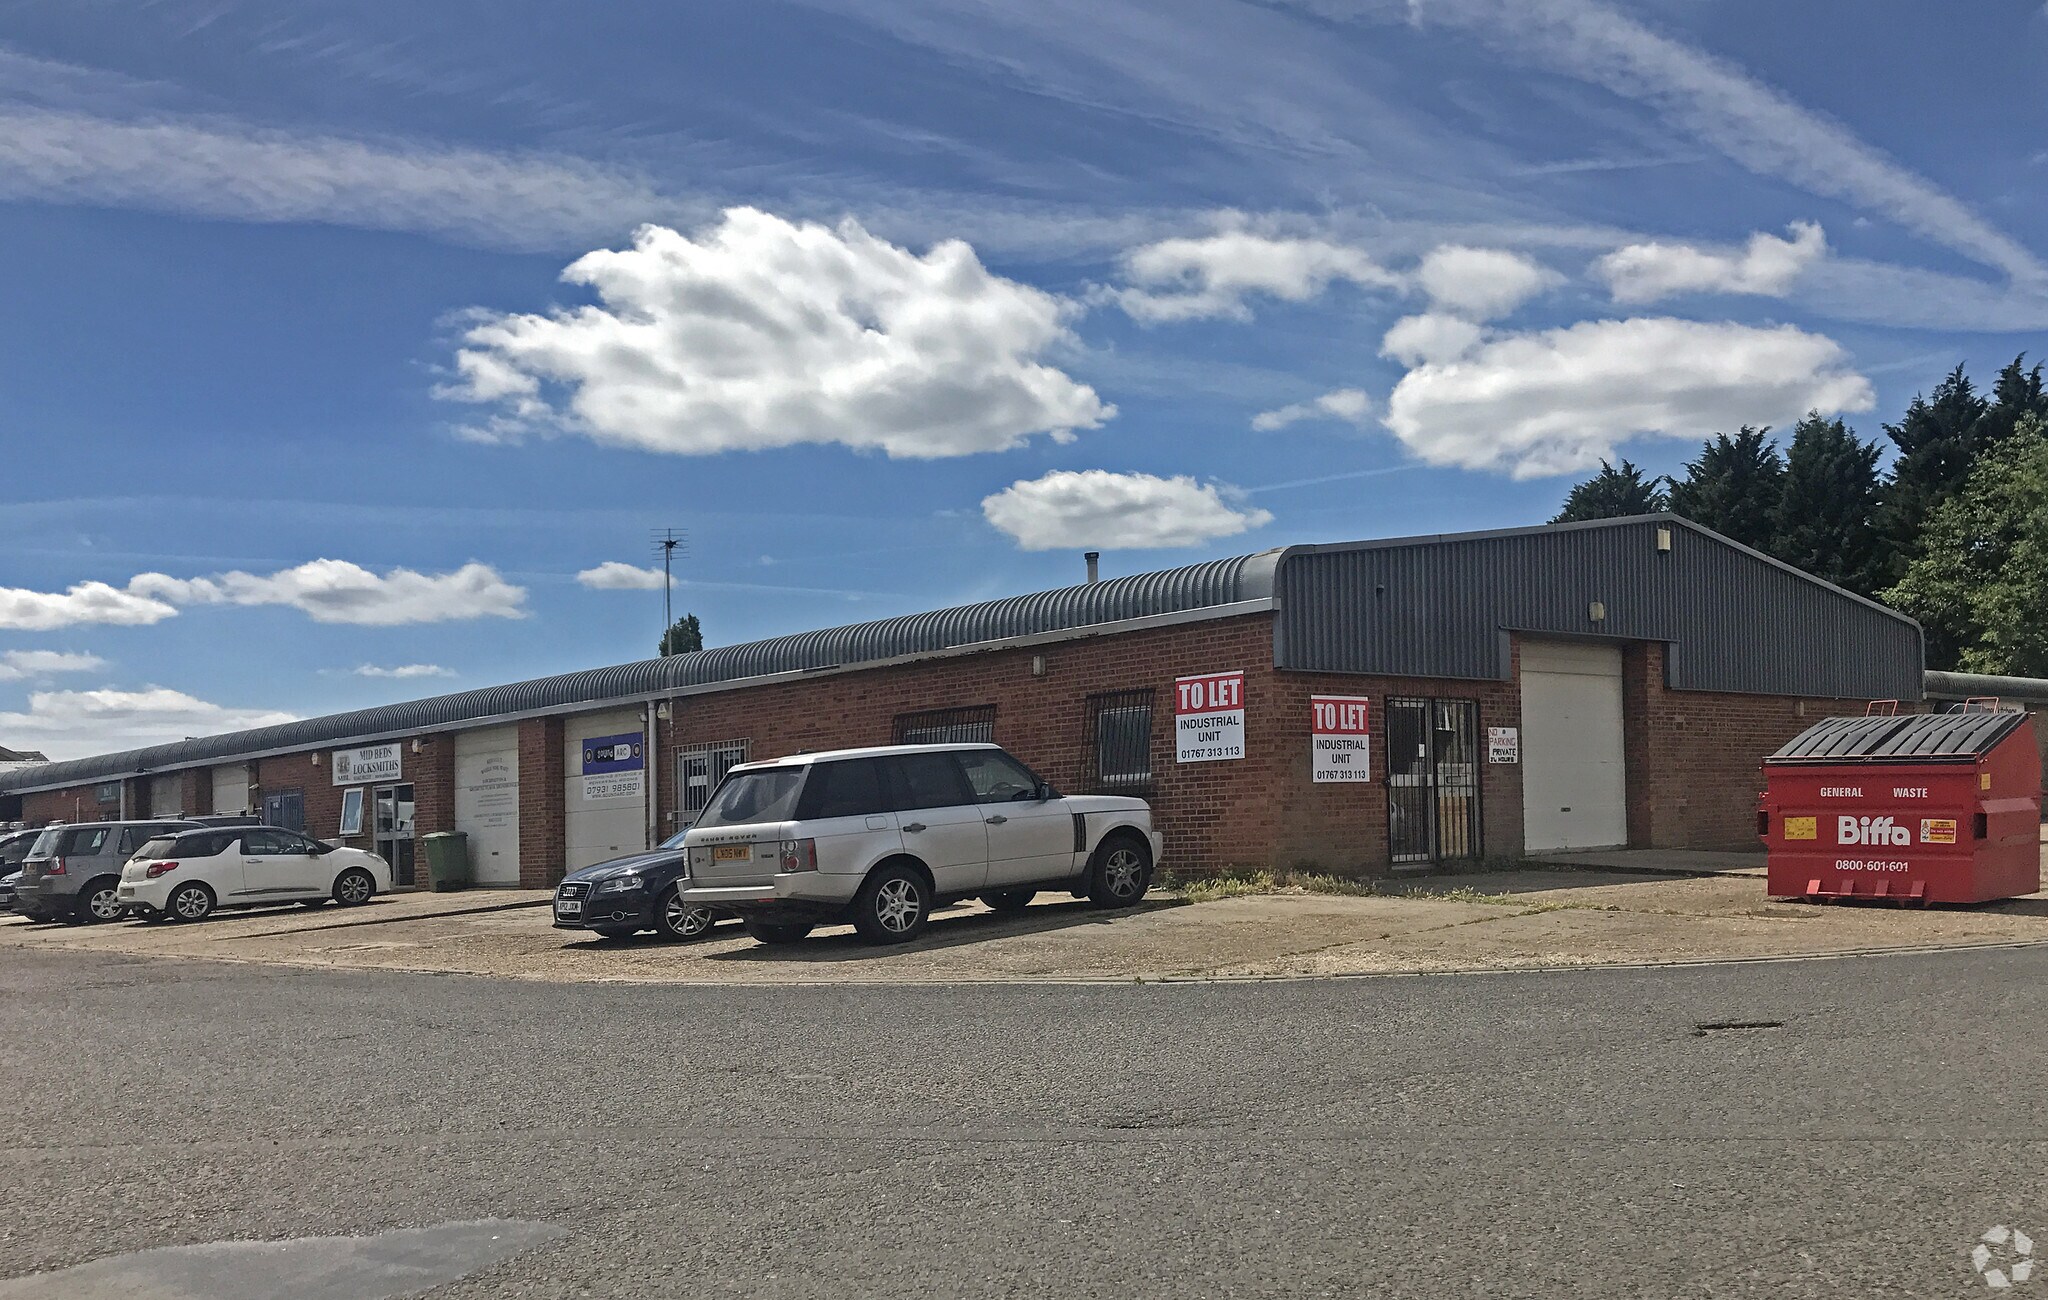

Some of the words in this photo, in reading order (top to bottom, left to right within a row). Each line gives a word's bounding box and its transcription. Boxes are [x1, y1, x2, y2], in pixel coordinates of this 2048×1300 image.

[1178, 682, 1204, 710] TO
[1208, 679, 1240, 708] LET
[1314, 703, 1336, 730] TO
[1340, 704, 1366, 730] LET
[1180, 716, 1240, 730] INDUSTRIAL
[1198, 731, 1221, 742] UNIT
[1490, 738, 1516, 746] PARKING
[1316, 740, 1366, 750] INDUSTRIAL
[360, 750, 374, 760] MID
[375, 747, 392, 760] BEDS
[1181, 749, 1206, 758] 01767
[1208, 748, 1222, 757] 313
[1224, 746, 1240, 756] 113
[1492, 748, 1516, 756] PRIVATE
[1332, 754, 1351, 764] UNIT
[353, 760, 399, 774] LOCKSMITHS
[1317, 770, 1338, 780] 01767
[1340, 770, 1352, 779] 313
[1354, 770, 1366, 779] 113
[586, 785, 608, 794] 07931
[1820, 787, 1864, 798] GENERAL
[1893, 787, 1928, 798] WASTE
[1838, 816, 1910, 846] Biffa
